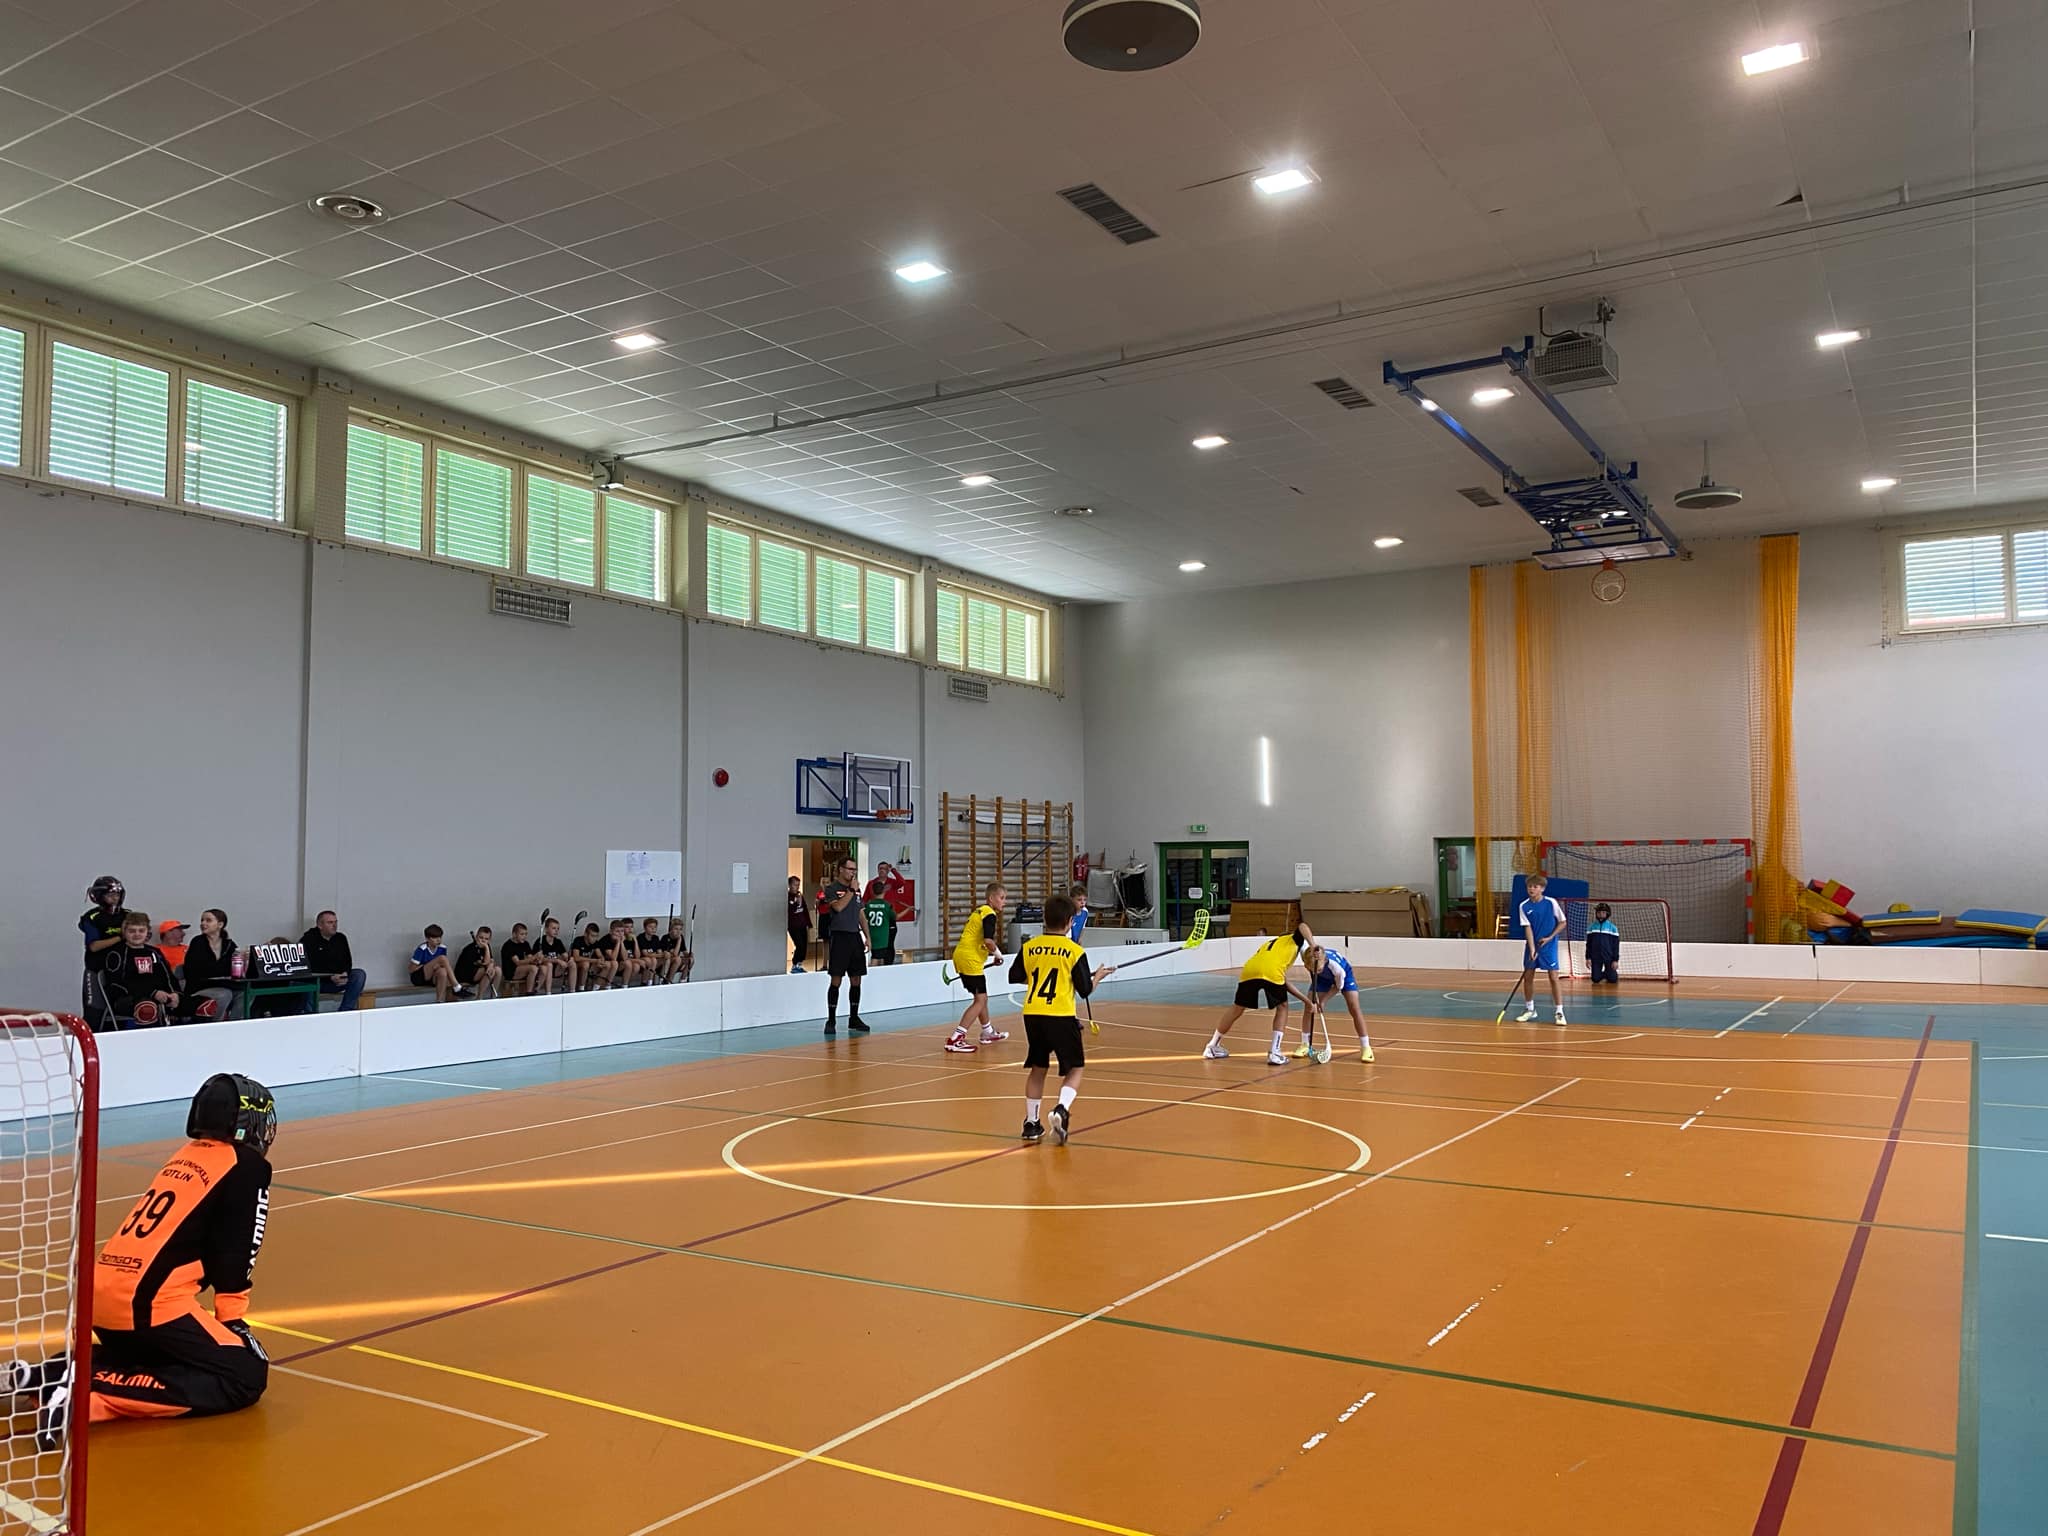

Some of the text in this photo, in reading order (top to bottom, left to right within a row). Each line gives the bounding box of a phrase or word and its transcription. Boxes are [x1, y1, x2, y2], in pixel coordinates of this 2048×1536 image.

[868, 910, 884, 927] 26
[1028, 946, 1071, 958] KOTLIN
[1028, 967, 1058, 1004] 14
[121, 1189, 176, 1238] 39
